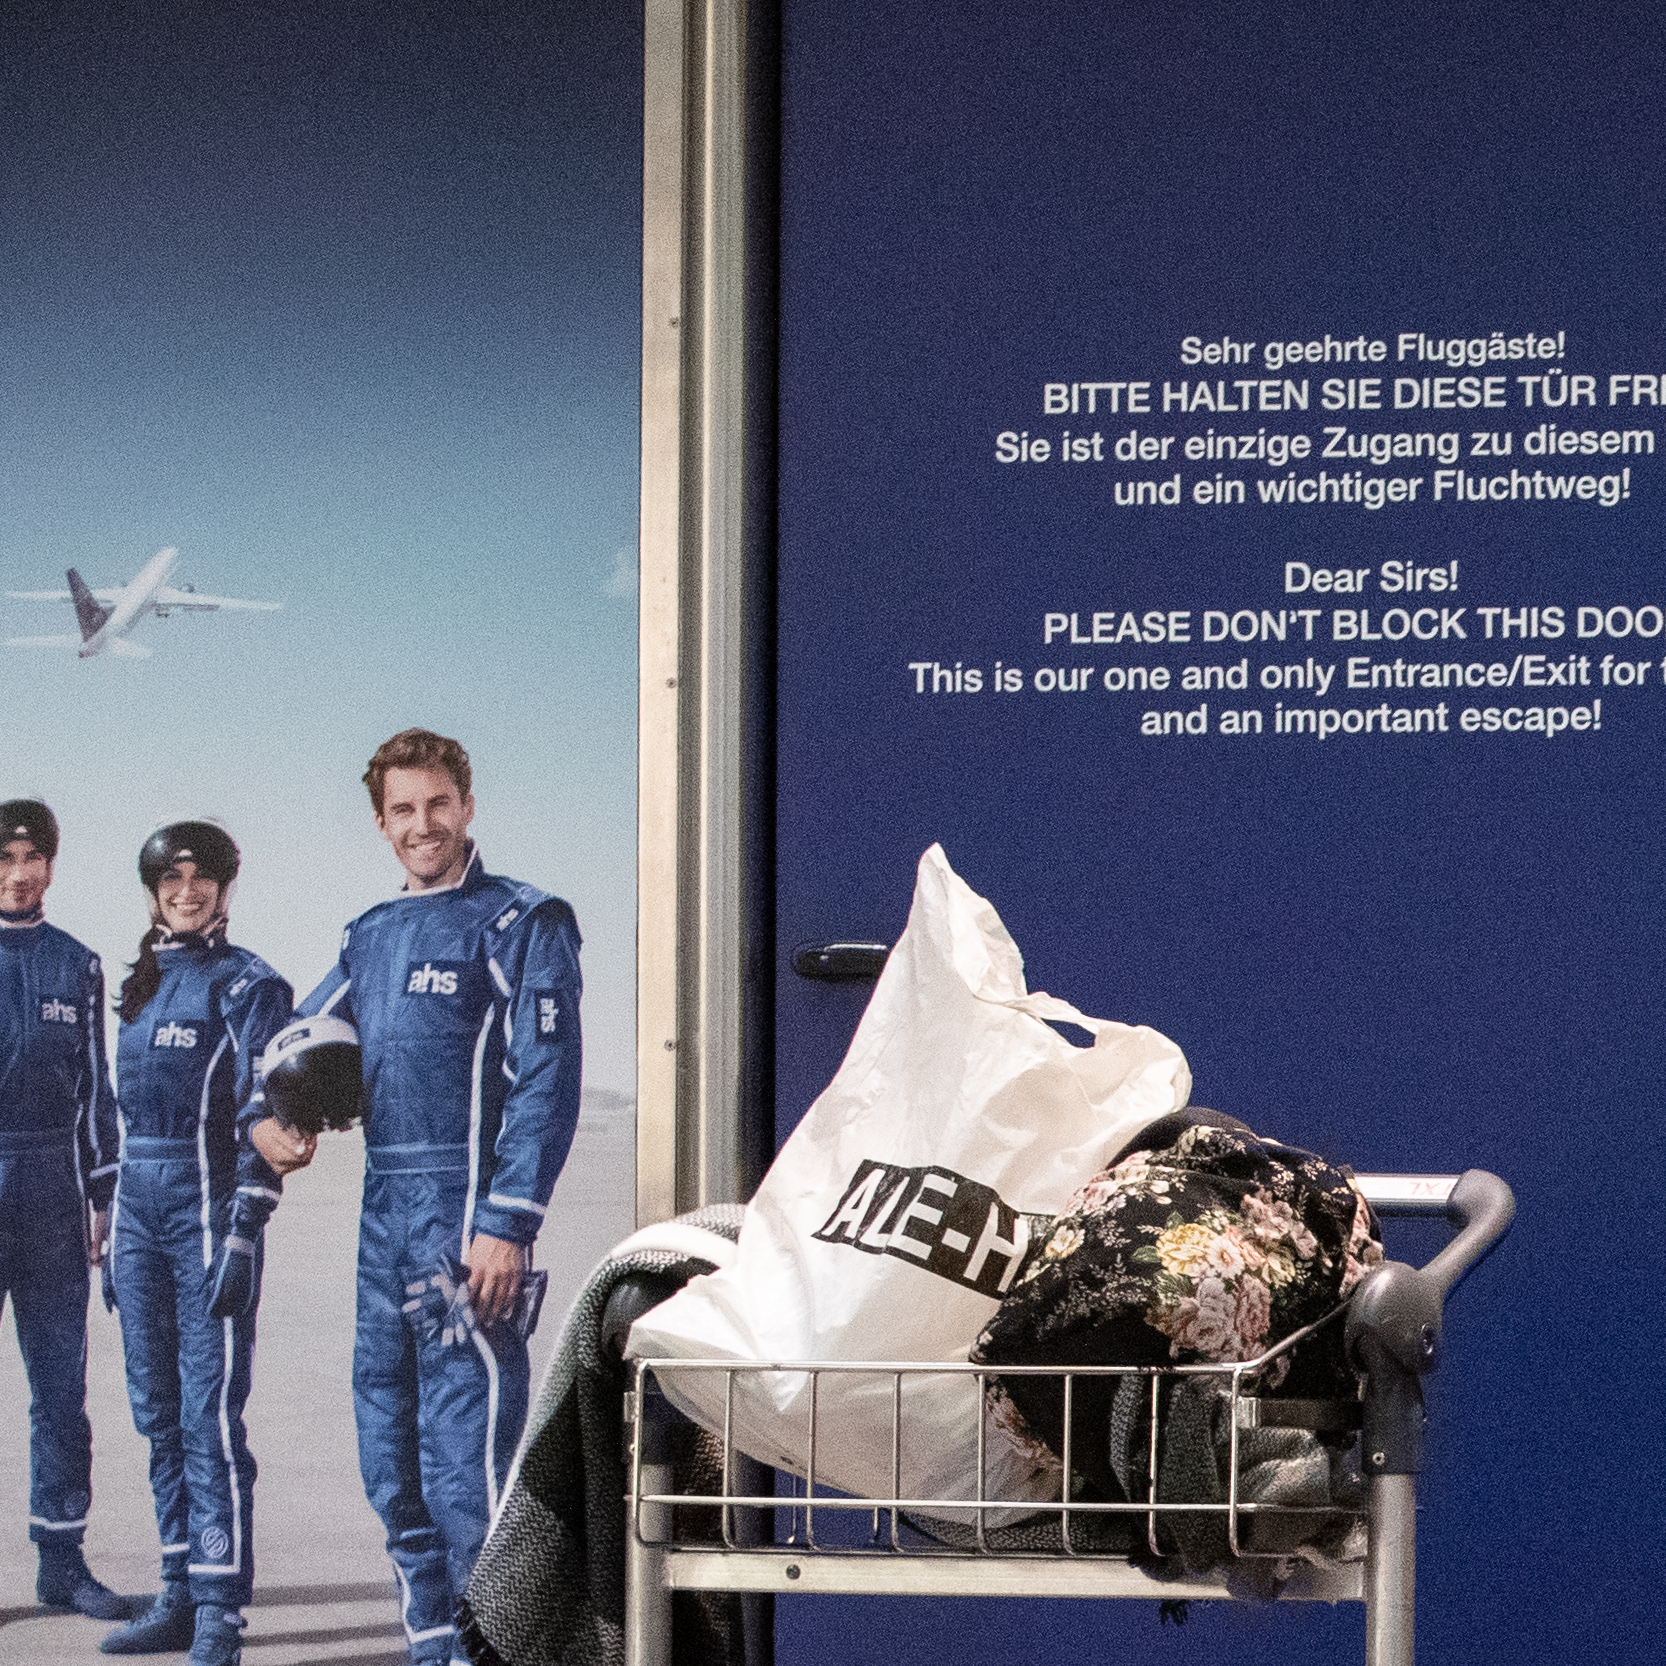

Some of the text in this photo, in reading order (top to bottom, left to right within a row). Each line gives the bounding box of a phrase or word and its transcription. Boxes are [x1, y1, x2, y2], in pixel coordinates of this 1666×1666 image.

[1180, 330, 1565, 370] Sehr geehrte Fluggäste!
[1043, 381, 1151, 414] BITTE
[1163, 379, 1309, 413] HALTEN
[1321, 378, 1382, 411] SIE
[1394, 376, 1507, 409] DIESE
[1516, 368, 1596, 407] TÜR
[995, 430, 1051, 463] Sie
[1062, 430, 1104, 462] ist
[1114, 429, 1176, 461] der
[1184, 427, 1312, 467] einzige
[1321, 426, 1459, 466] Zugang
[1470, 432, 1512, 456] zu
[1523, 423, 1655, 456] diesem
[1114, 467, 1631, 510] und ein wichtiger Fluchtweg!
[1284, 559, 1458, 593] Dear Sirs!
[1044, 610, 1191, 644] PLEASE
[1203, 609, 1322, 642] DON'T
[1332, 607, 1467, 641] BLOCK
[1476, 606, 1566, 639] THIS
[908, 661, 983, 693] This
[994, 661, 1023, 693] is
[1033, 667, 1095, 692] our
[1103, 666, 1171, 691] one
[1181, 658, 1248, 691] and
[1260, 657, 1336, 697] only
[1347, 654, 1591, 688] Entrance/Exit
[1599, 654, 1652, 686] for
[1140, 698, 1601, 740] and an important escape!
[407, 963, 458, 995] ahs
[42, 998, 77, 1024] ahs
[155, 1021, 197, 1048] ahs
